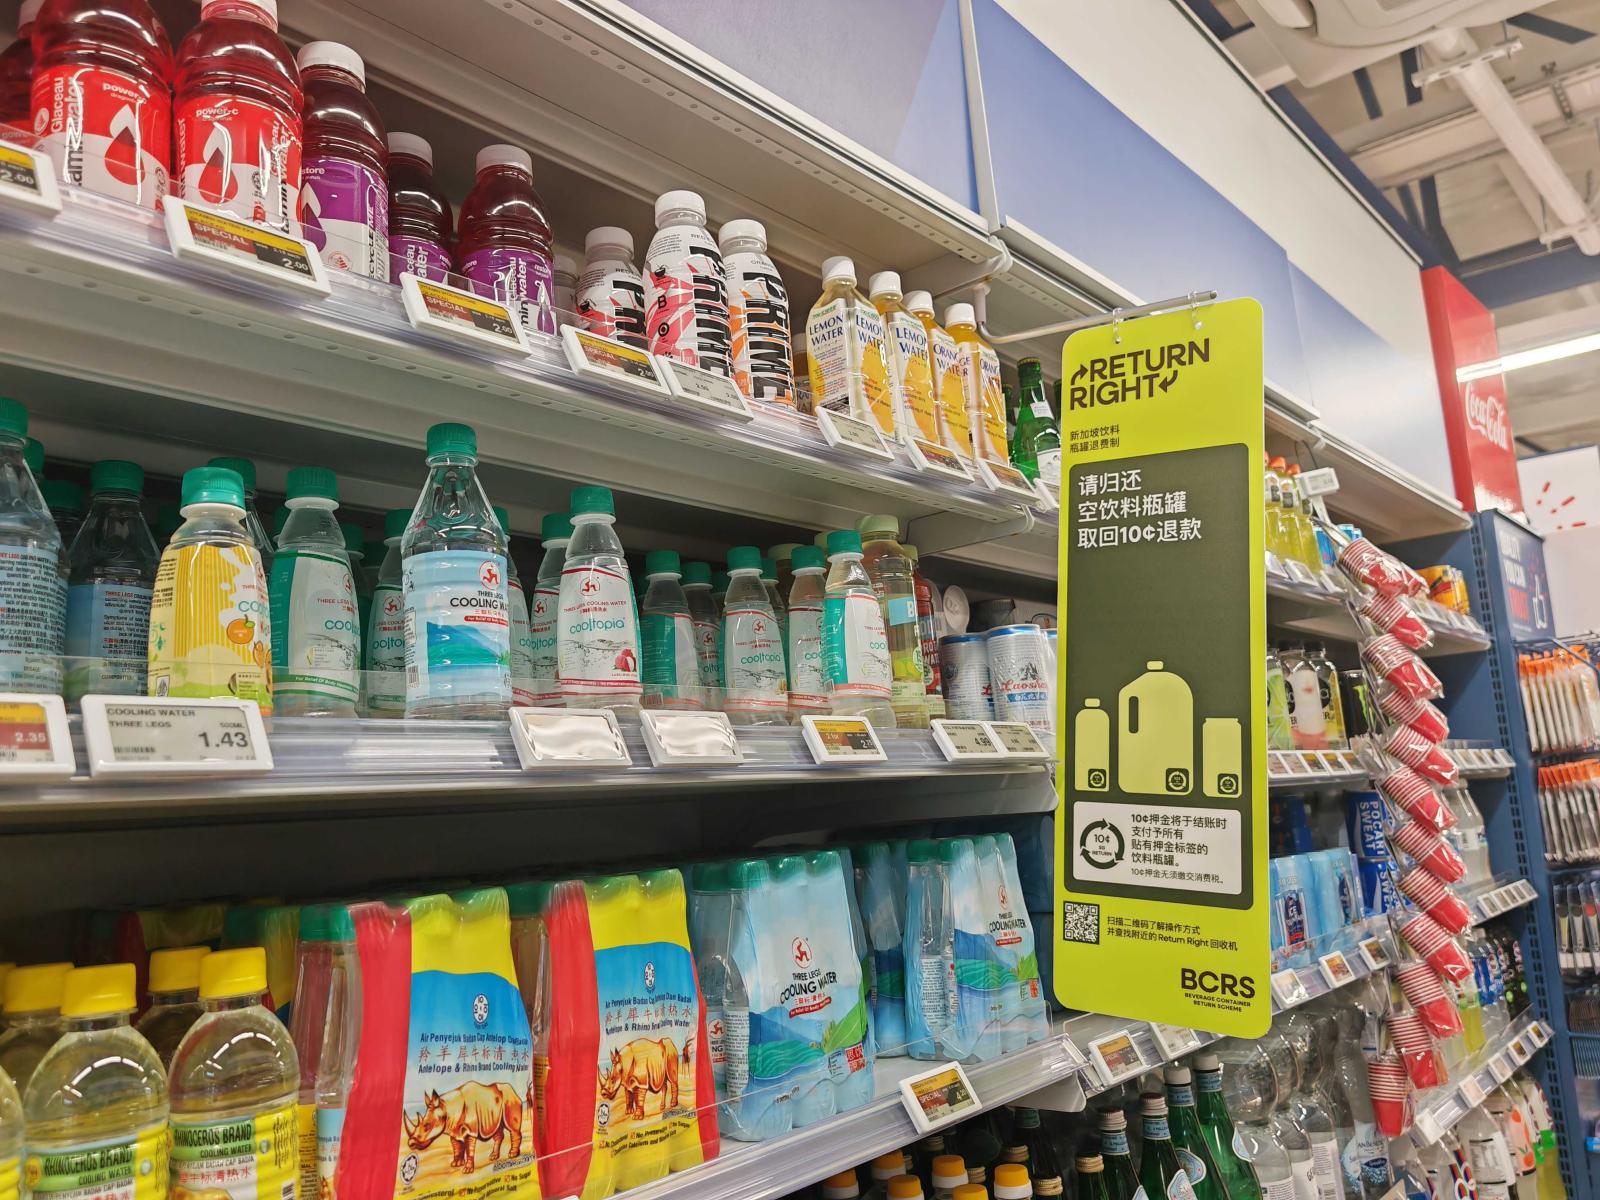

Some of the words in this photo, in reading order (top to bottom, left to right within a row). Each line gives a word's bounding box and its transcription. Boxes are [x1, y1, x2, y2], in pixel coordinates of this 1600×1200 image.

[51, 77, 64, 133] Glaceau
[194, 223, 249, 246] SPECIAL
[426, 296, 467, 314] SPECIAL
[809, 314, 844, 336] LEMON
[811, 326, 844, 346] WATER
[937, 357, 961, 376] WATE
[1090, 338, 1210, 382] RETURN
[1070, 373, 1160, 411] RIGHT
[1070, 424, 1121, 442] 新加坡饮料
[1070, 437, 1121, 454] 瓶罐退费制
[1078, 469, 1142, 497] 请归还
[1077, 491, 1188, 523] 空饮料瓶罐
[1077, 518, 1203, 549] 取回10¢退款
[477, 590, 494, 598] THREE
[450, 597, 499, 610] COOLING
[569, 617, 626, 635] cooltopia
[106, 707, 156, 717] COOLING
[157, 708, 196, 717] WATER
[109, 719, 143, 728] THREE
[145, 720, 172, 729] LEGS
[15, 731, 46, 744] 2.35
[198, 731, 249, 749] 1.43
[975, 736, 992, 748] 4.99
[1131, 813, 1228, 830] 10¢押金将于结账时
[1360, 801, 1376, 849] SWEAT
[1131, 826, 1184, 840] 支付予所有
[1131, 839, 1208, 856] 贴有押金标签的
[1131, 852, 1180, 868] 饮料瓶罐。
[1107, 915, 1201, 936] 扫描二维码了解操作方式
[1107, 927, 1158, 942] 并查找附近的
[1158, 933, 1186, 945] Return
[1187, 936, 1209, 949] Right
[1210, 938, 1239, 952] 回收机
[792, 973, 807, 981] THREE
[808, 968, 821, 980] LEGS
[1181, 967, 1256, 999] BCRS
[780, 981, 817, 1005] COOLING
[817, 971, 838, 990] WATER
[632, 997, 649, 1006] Badan
[1184, 992, 1216, 1002] BEVERAGE
[1216, 996, 1251, 1008] CONTAINER
[1193, 999, 1217, 1009] RETURN
[1217, 1003, 1243, 1013] SCHEME
[624, 1023, 629, 1032] &
[631, 1022, 651, 1032] Rhino
[674, 1019, 690, 1028] Water
[420, 1033, 430, 1042] Air
[430, 1033, 462, 1045] Penyejuk
[477, 1032, 486, 1044] Cap
[418, 1062, 454, 1077] Antelope
[454, 1062, 461, 1073] &
[462, 1062, 478, 1073] Rhino
[478, 1061, 492, 1072] Brand
[492, 1061, 516, 1073] Cooling
[678, 1121, 690, 1129] Sugar
[174, 1128, 221, 1148] RHINOCEROS
[222, 1123, 252, 1143] BRAND
[200, 1147, 231, 1159] COOLING
[231, 1144, 252, 1156] WATER
[44, 1151, 98, 1177] RHINOCEROS
[99, 1144, 133, 1167] BRAND
[225, 1157, 237, 1167] CAP
[78, 1172, 107, 1186] COOLING
[108, 1165, 133, 1179] WATER
[518, 1170, 532, 1182] Sugar
[103, 1183, 116, 1192] CAP
